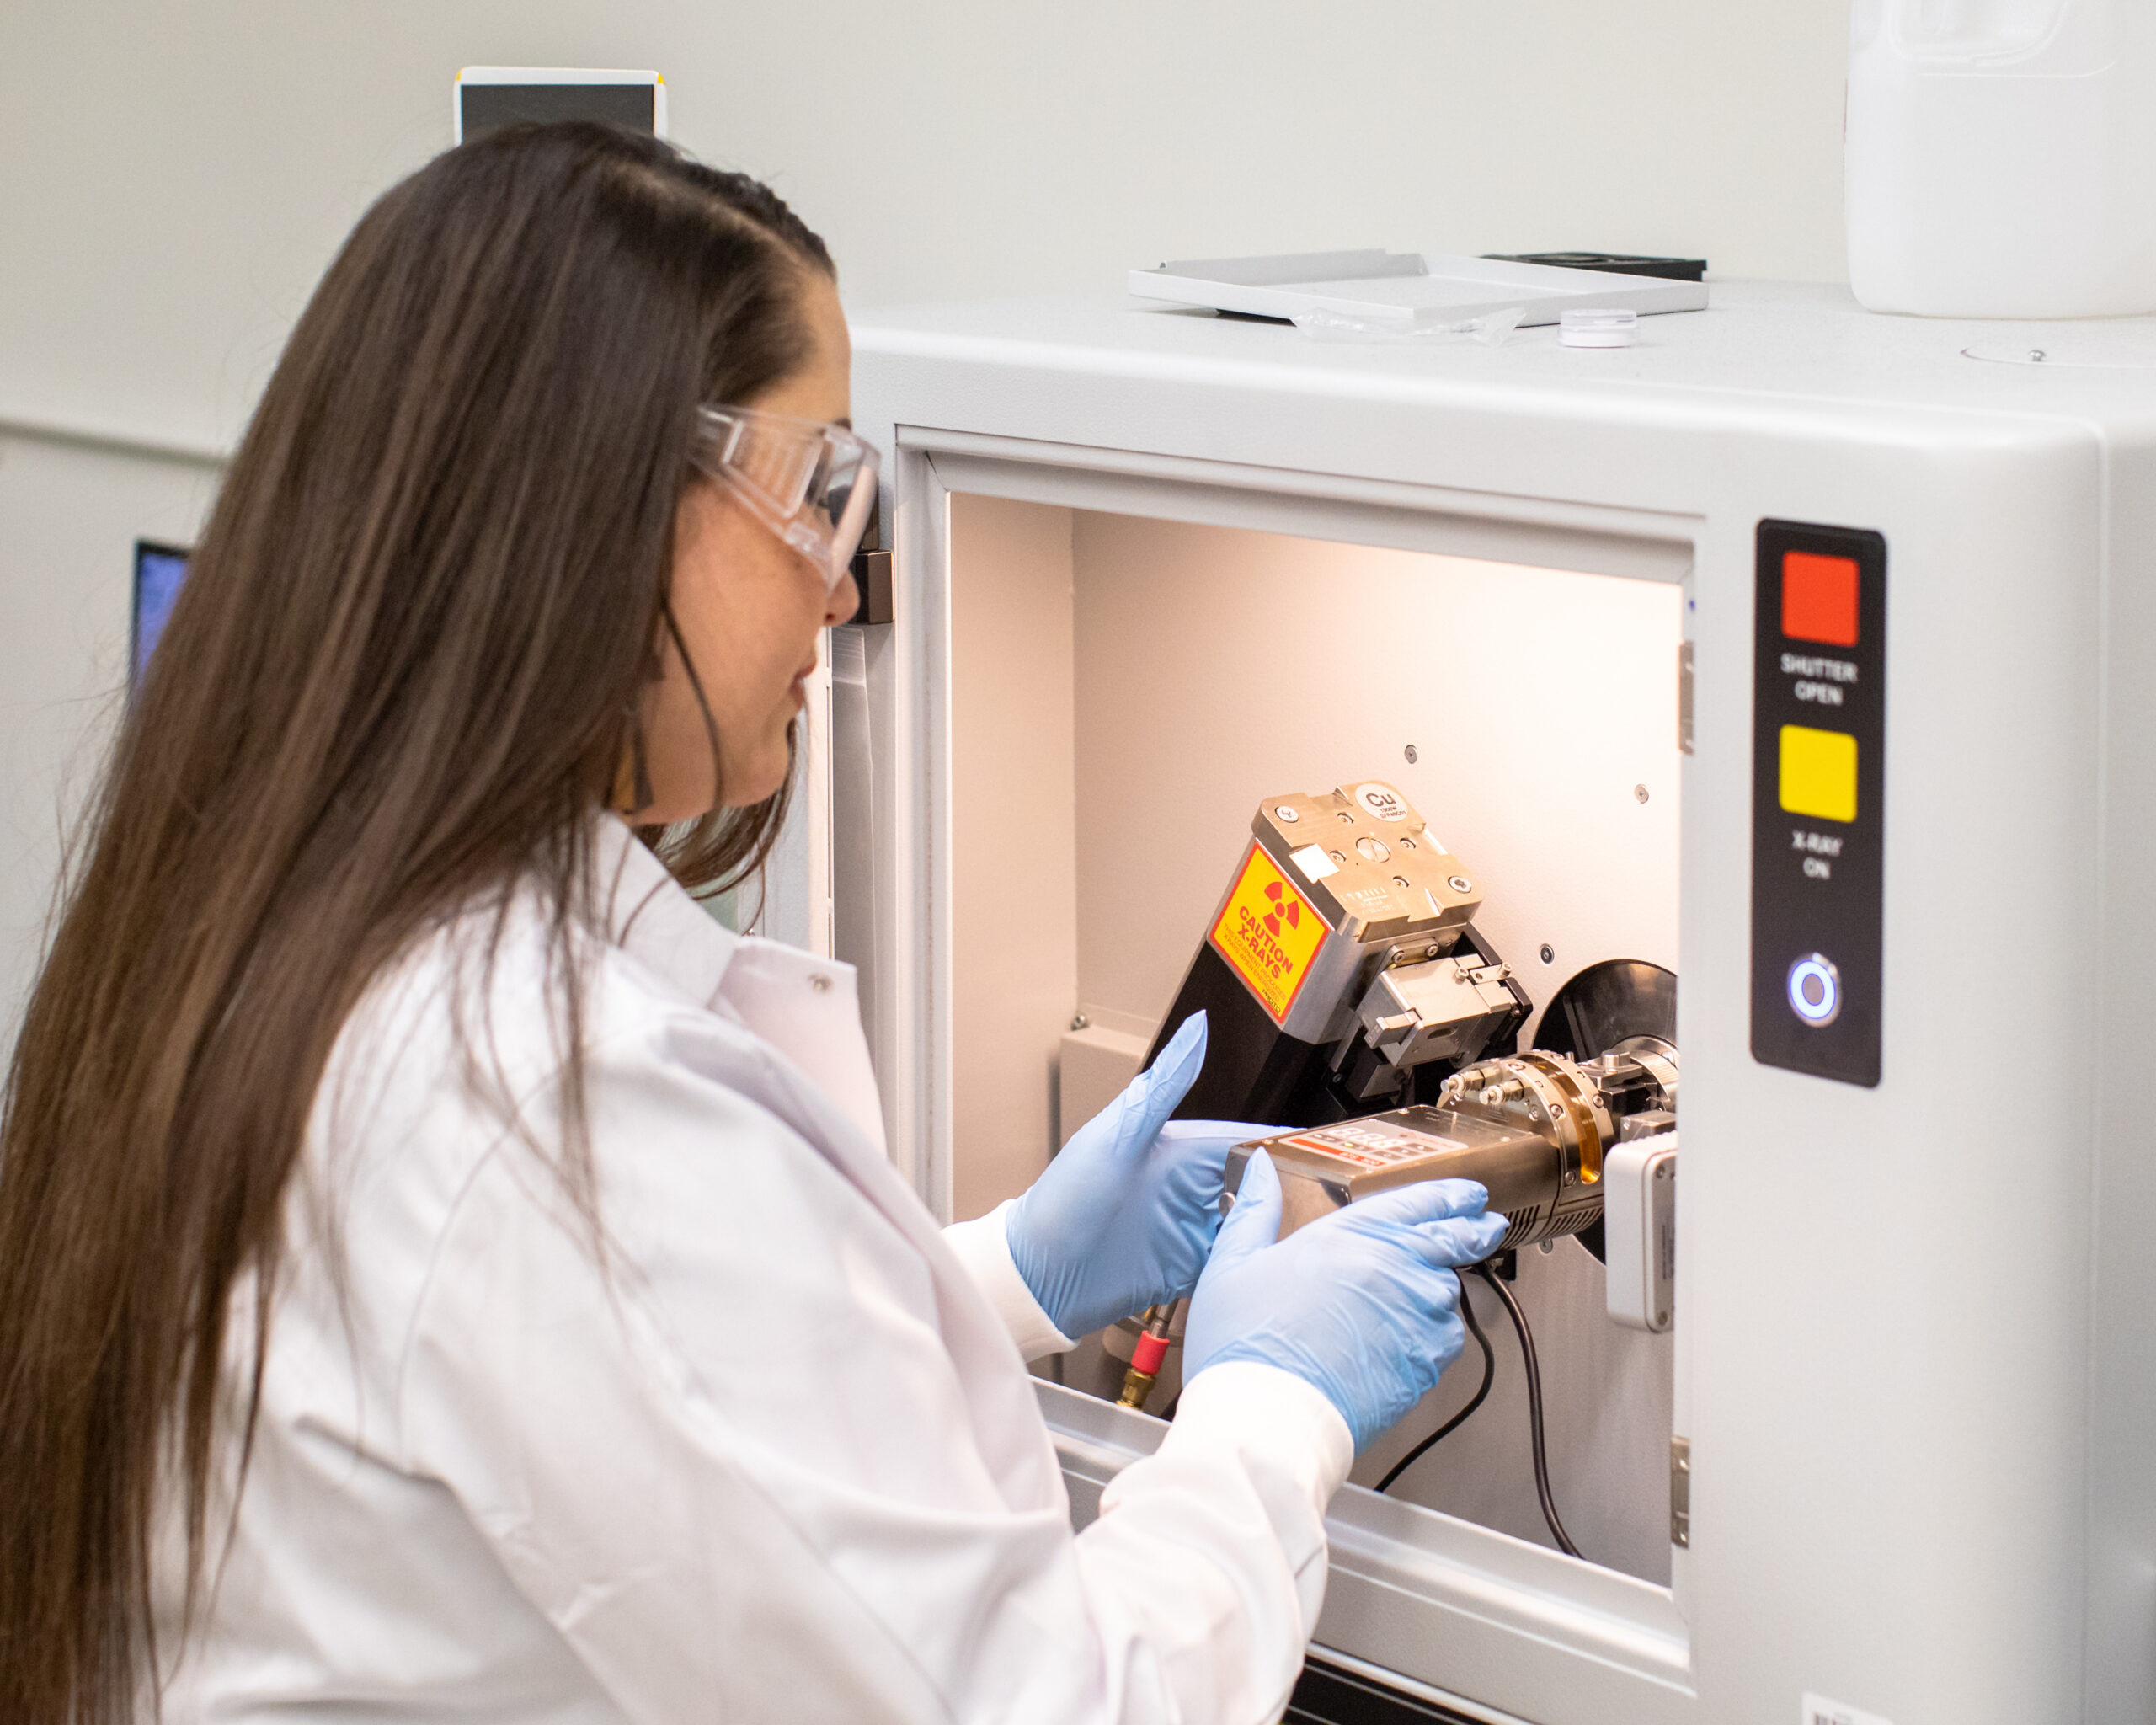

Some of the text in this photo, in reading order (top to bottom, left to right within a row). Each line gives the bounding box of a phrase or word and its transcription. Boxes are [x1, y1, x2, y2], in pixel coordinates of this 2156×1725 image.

[1781, 653, 1858, 683] SHUTTER
[1795, 680, 1843, 705] OPEN
[1366, 793, 1396, 806] Cu
[1792, 830, 1843, 857] X-RAY
[1803, 857, 1830, 879] ON
[1237, 925, 1281, 979] X-RAYS
[1239, 906, 1294, 975] CAUTION
[1234, 936, 1261, 968] EQUIPMENT
[1261, 968, 1286, 1001] PRODUCES
[1240, 953, 1253, 970] WHEN
